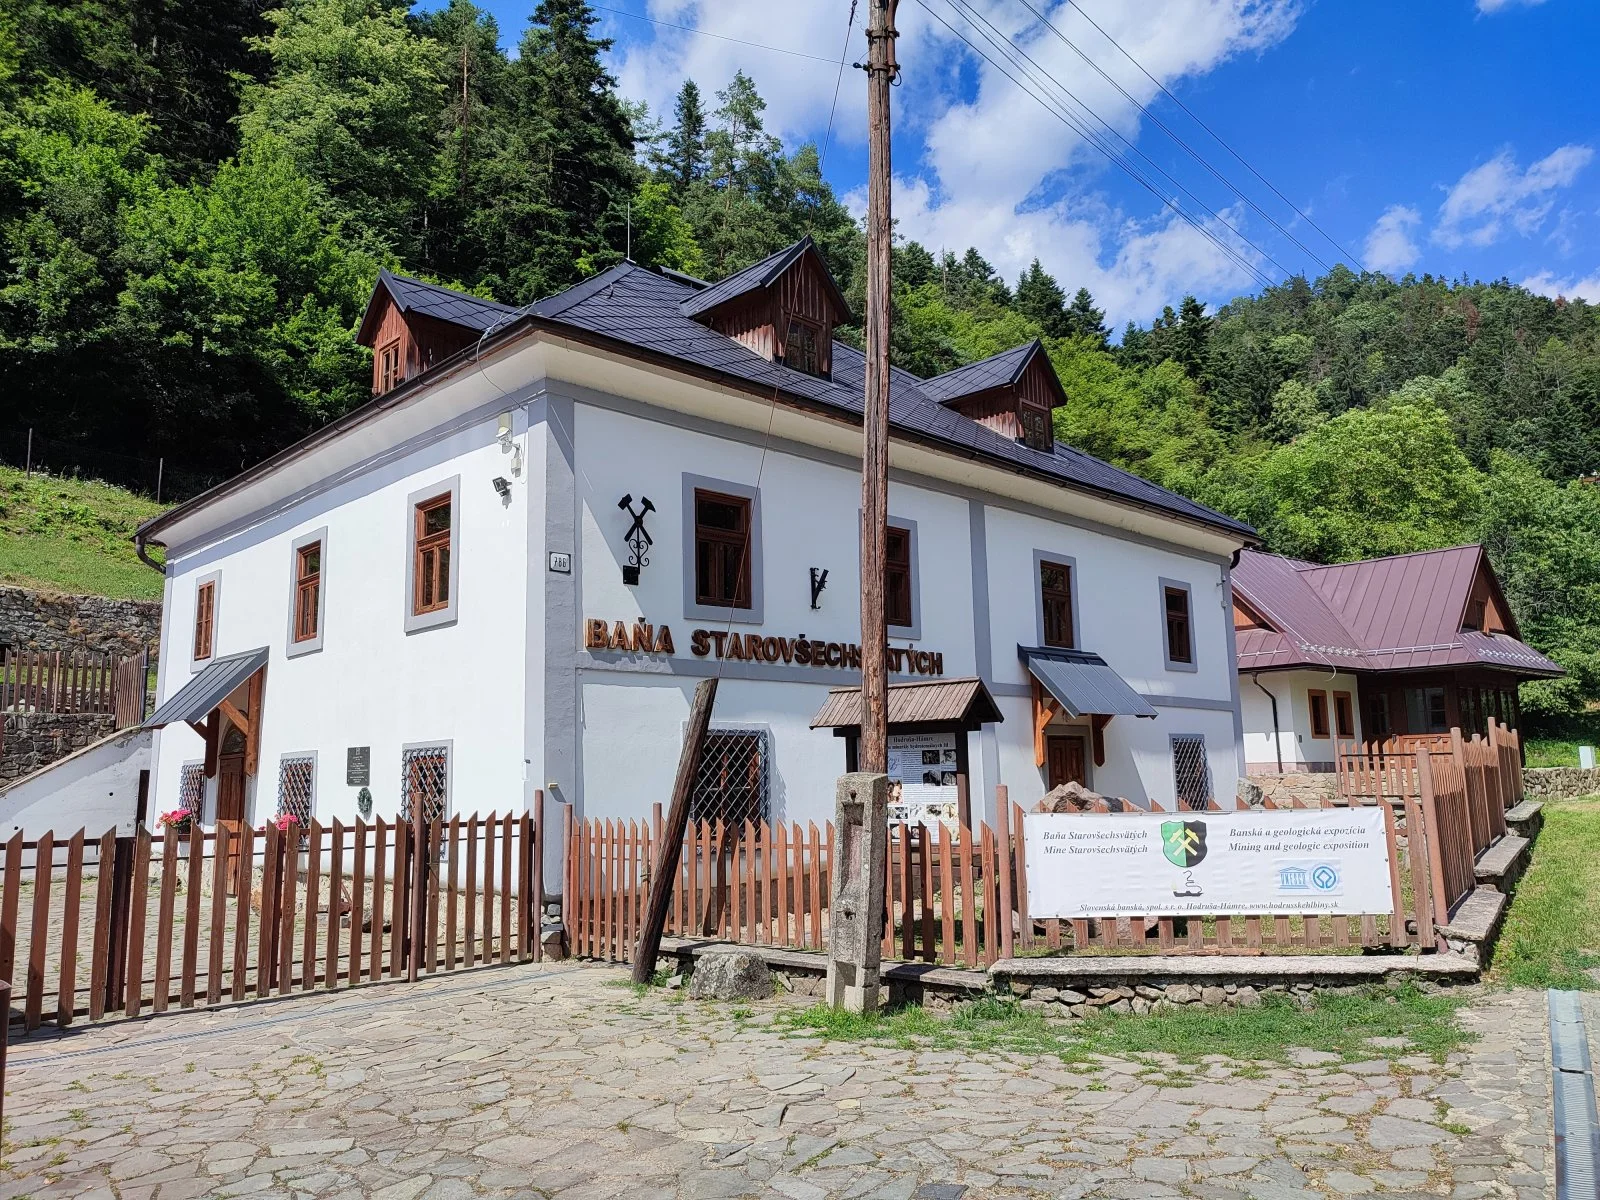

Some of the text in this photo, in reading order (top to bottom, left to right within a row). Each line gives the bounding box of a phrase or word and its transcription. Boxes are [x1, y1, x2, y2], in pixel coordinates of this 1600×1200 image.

[585, 616, 675, 654] BAŇA
[1043, 829, 1148, 841] Baňa Starovšechsvätých
[1229, 827, 1263, 837] Banská
[1273, 826, 1322, 838] geologická
[1324, 825, 1366, 838] expozícia
[1043, 844, 1148, 855] Mine Starovšechsvätých
[1228, 840, 1369, 852] Mining and geologic exposition
[1079, 903, 1116, 912] Slovenská
